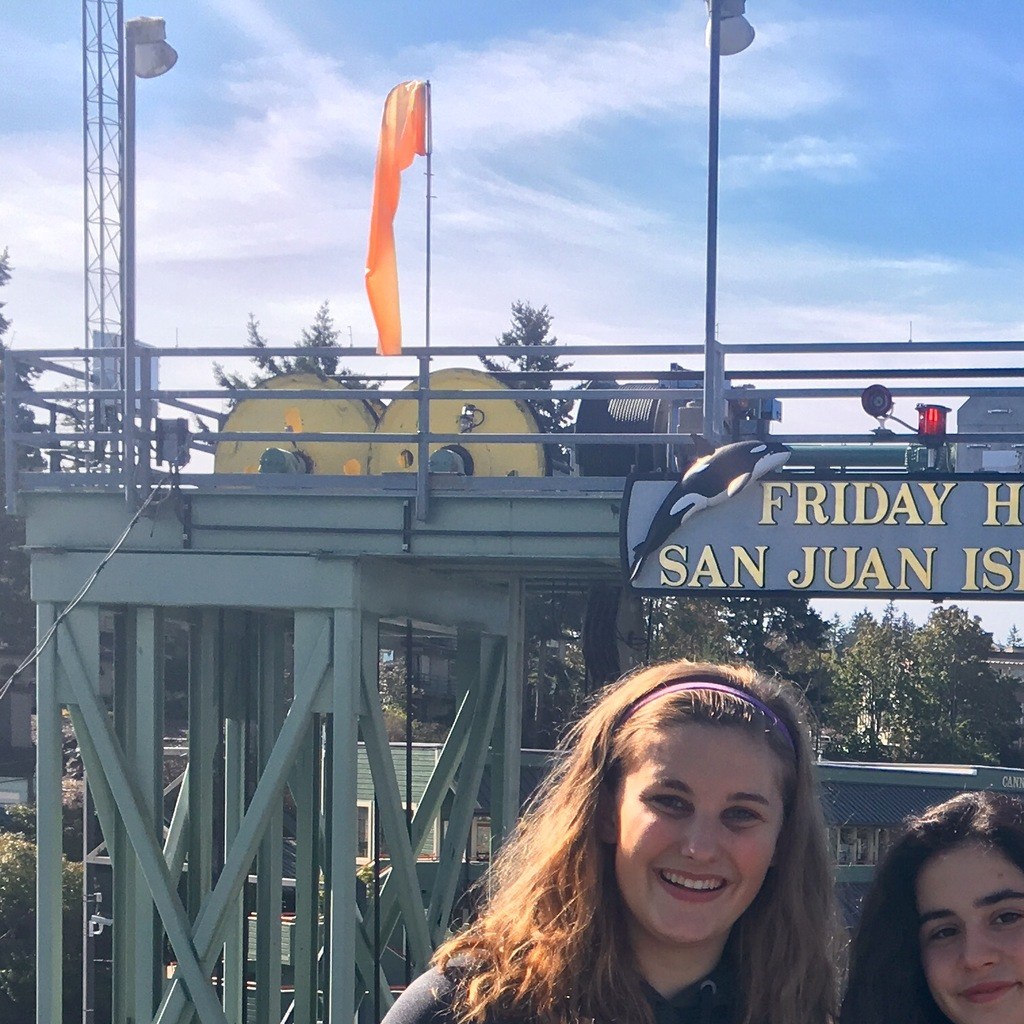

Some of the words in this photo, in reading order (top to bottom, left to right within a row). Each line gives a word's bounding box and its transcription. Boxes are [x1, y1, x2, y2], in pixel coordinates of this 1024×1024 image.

[758, 480, 955, 526] FRIDAY
[658, 544, 768, 587] SAN
[787, 546, 938, 590] JUAN
